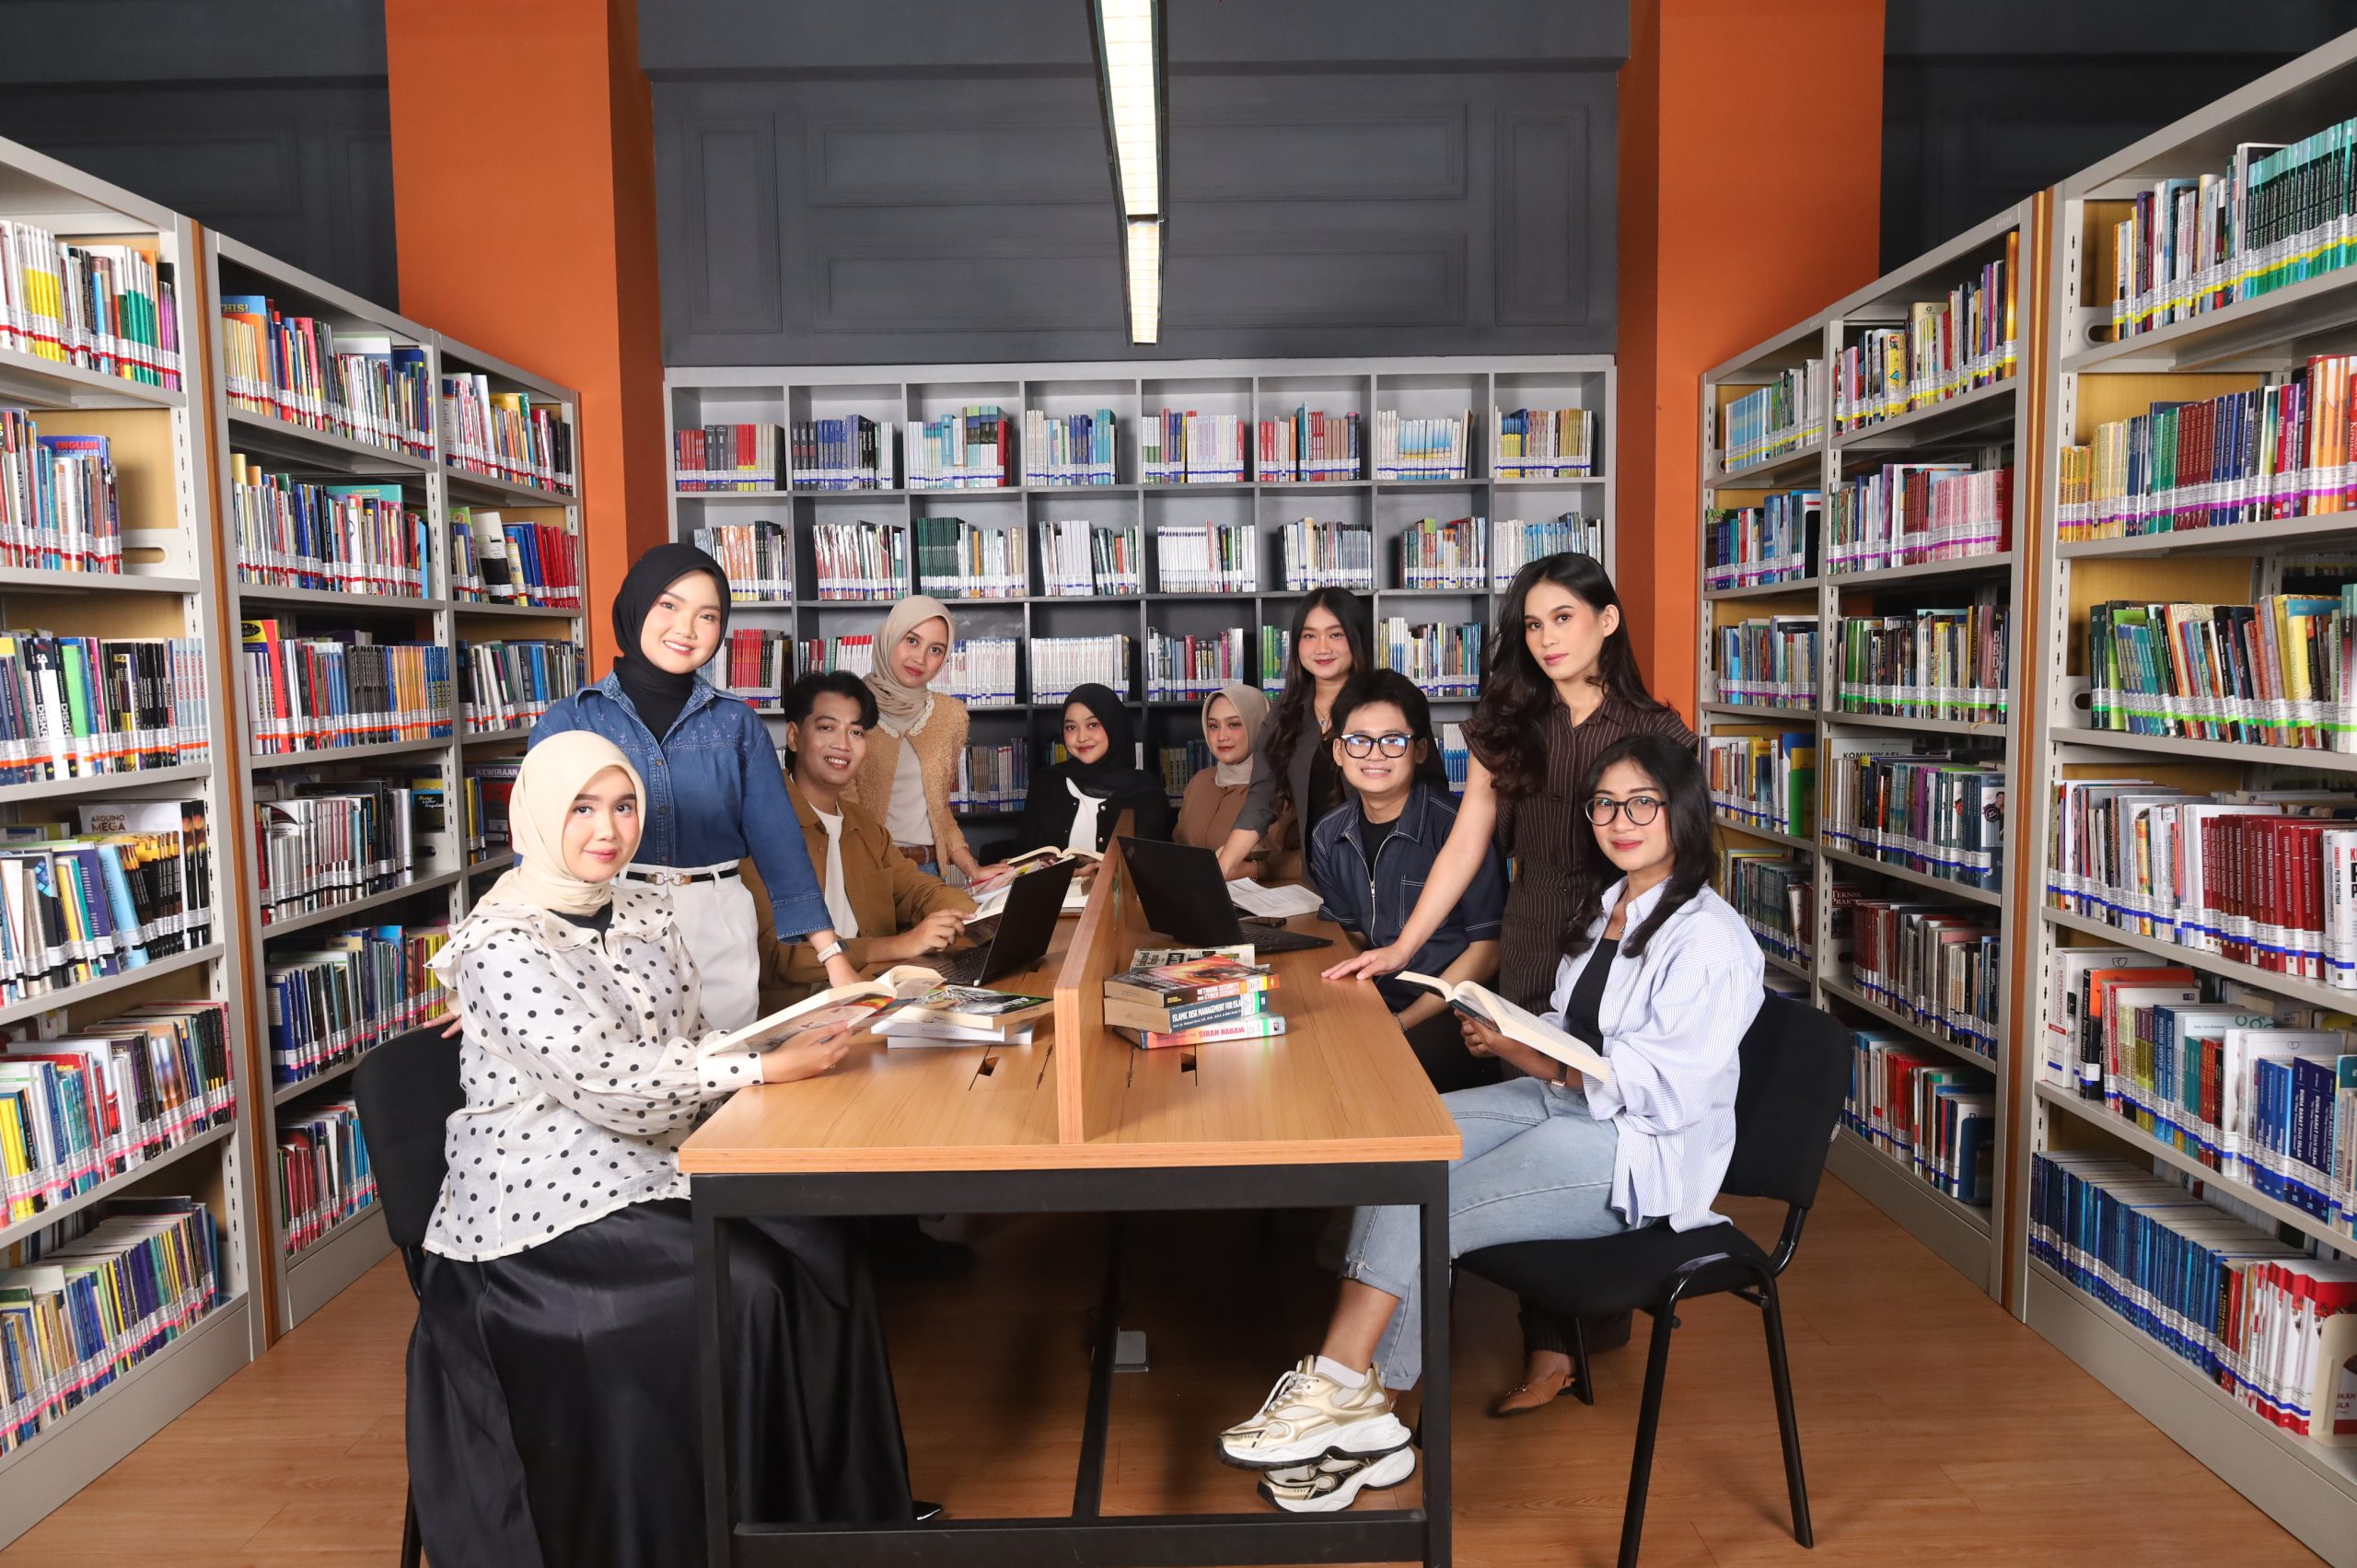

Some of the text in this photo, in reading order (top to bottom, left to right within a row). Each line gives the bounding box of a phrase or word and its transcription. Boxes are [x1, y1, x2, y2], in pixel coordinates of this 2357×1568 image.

[37, 704, 48, 737] DISKR
[62, 703, 71, 736] DISKR
[91, 814, 125, 822] ARDUINO
[91, 822, 125, 832] MEGA
[1172, 1012, 1188, 1022] ISLAMIC
[1189, 1009, 1199, 1017] RISK
[1199, 1005, 1224, 1016] MANAGEMENT
[1225, 1003, 1233, 1011] FOR
[1234, 1001, 1242, 1009] ISLA
[1199, 1029, 1220, 1038] SIRAH
